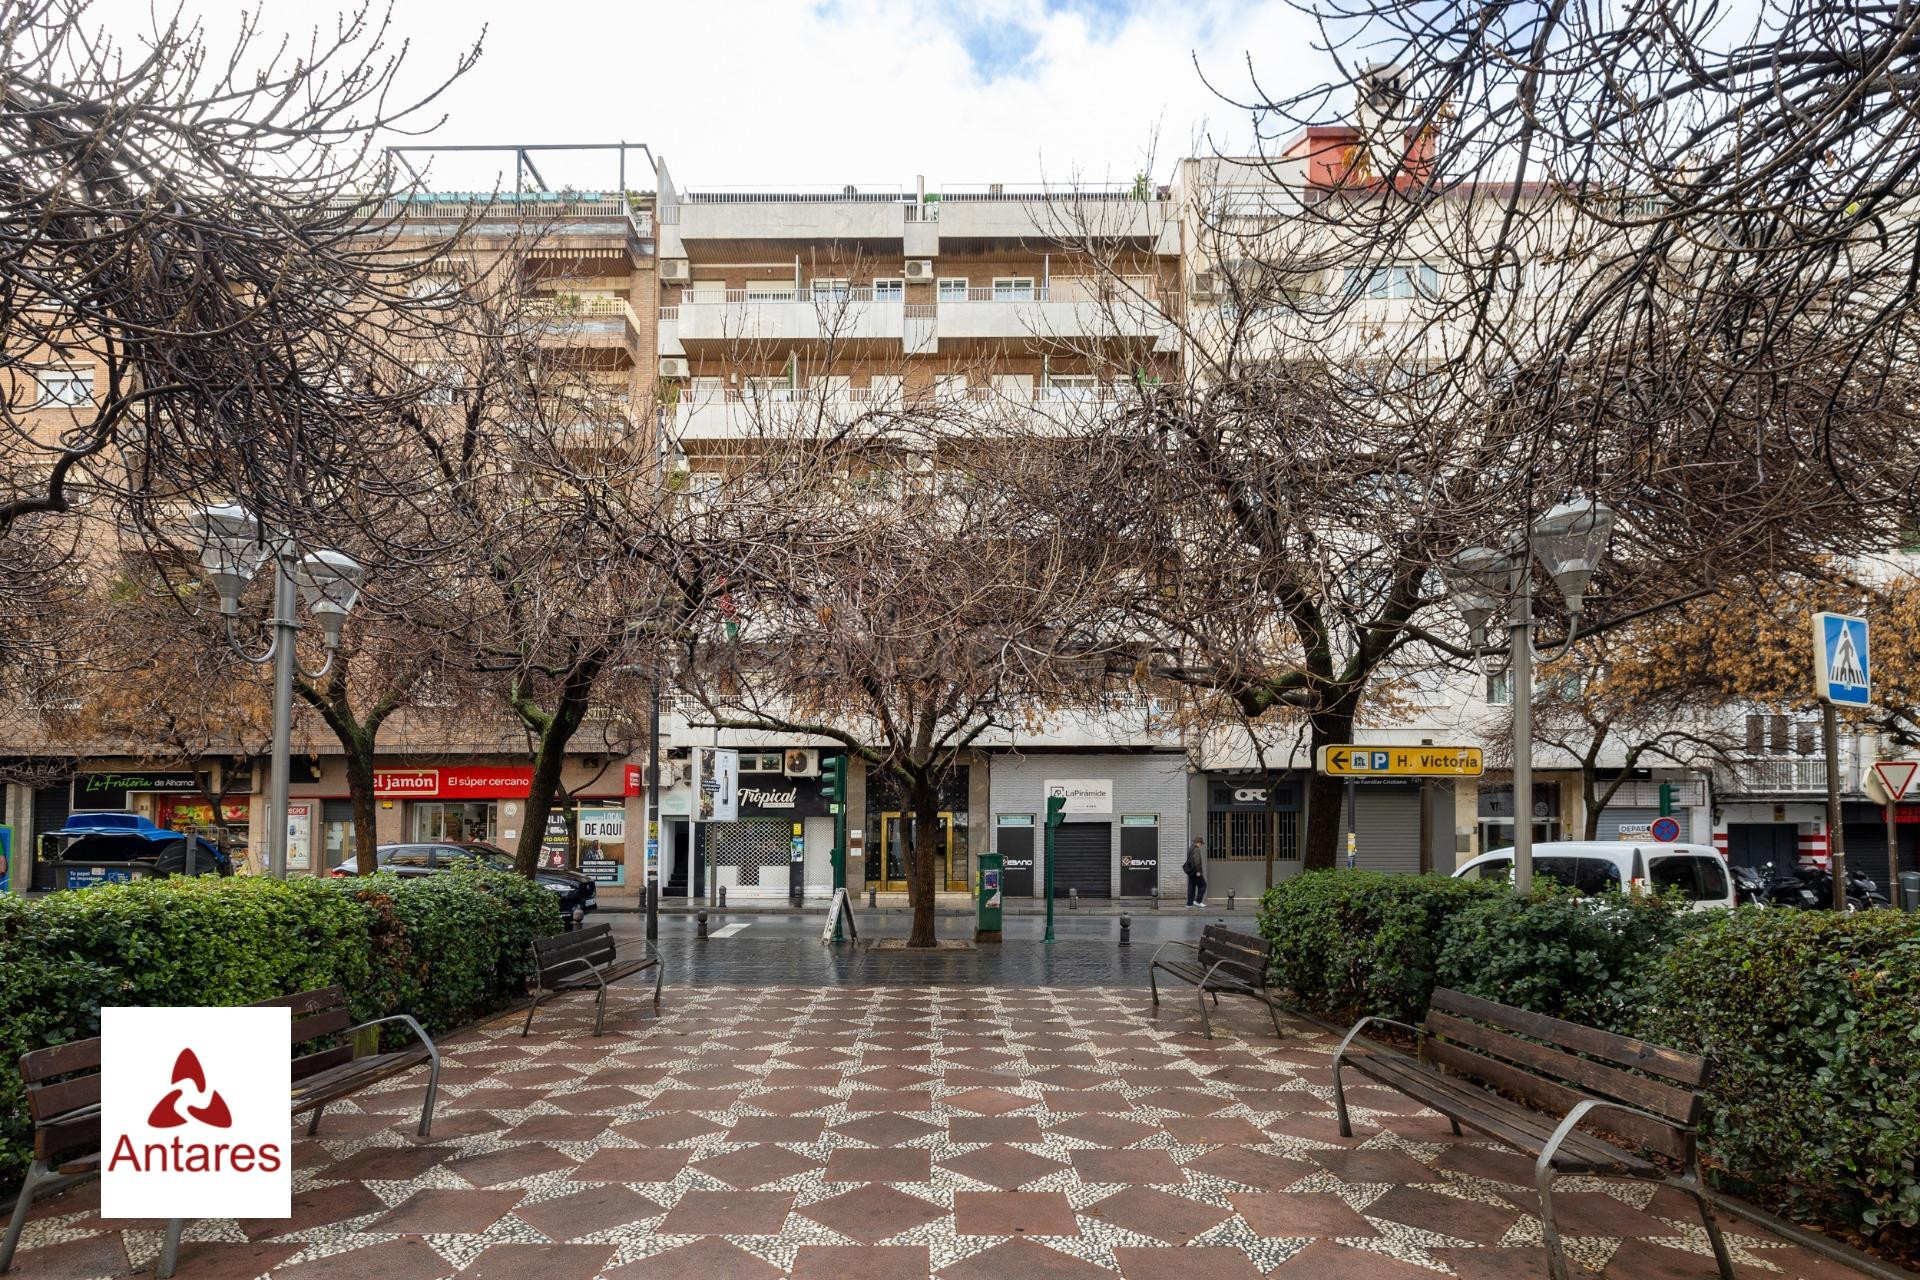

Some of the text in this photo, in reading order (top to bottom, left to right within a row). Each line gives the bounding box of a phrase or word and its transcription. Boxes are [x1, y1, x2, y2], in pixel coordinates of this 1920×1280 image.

[1375, 753, 1386, 768] P
[1397, 755, 1478, 768] H. Victoria
[86, 775, 103, 791] La
[155, 779, 165, 787] de
[384, 772, 433, 791] jamón
[448, 776, 529, 788] El súper cercano
[737, 788, 797, 808] Tropical
[585, 821, 622, 836] DE AQUÍ
